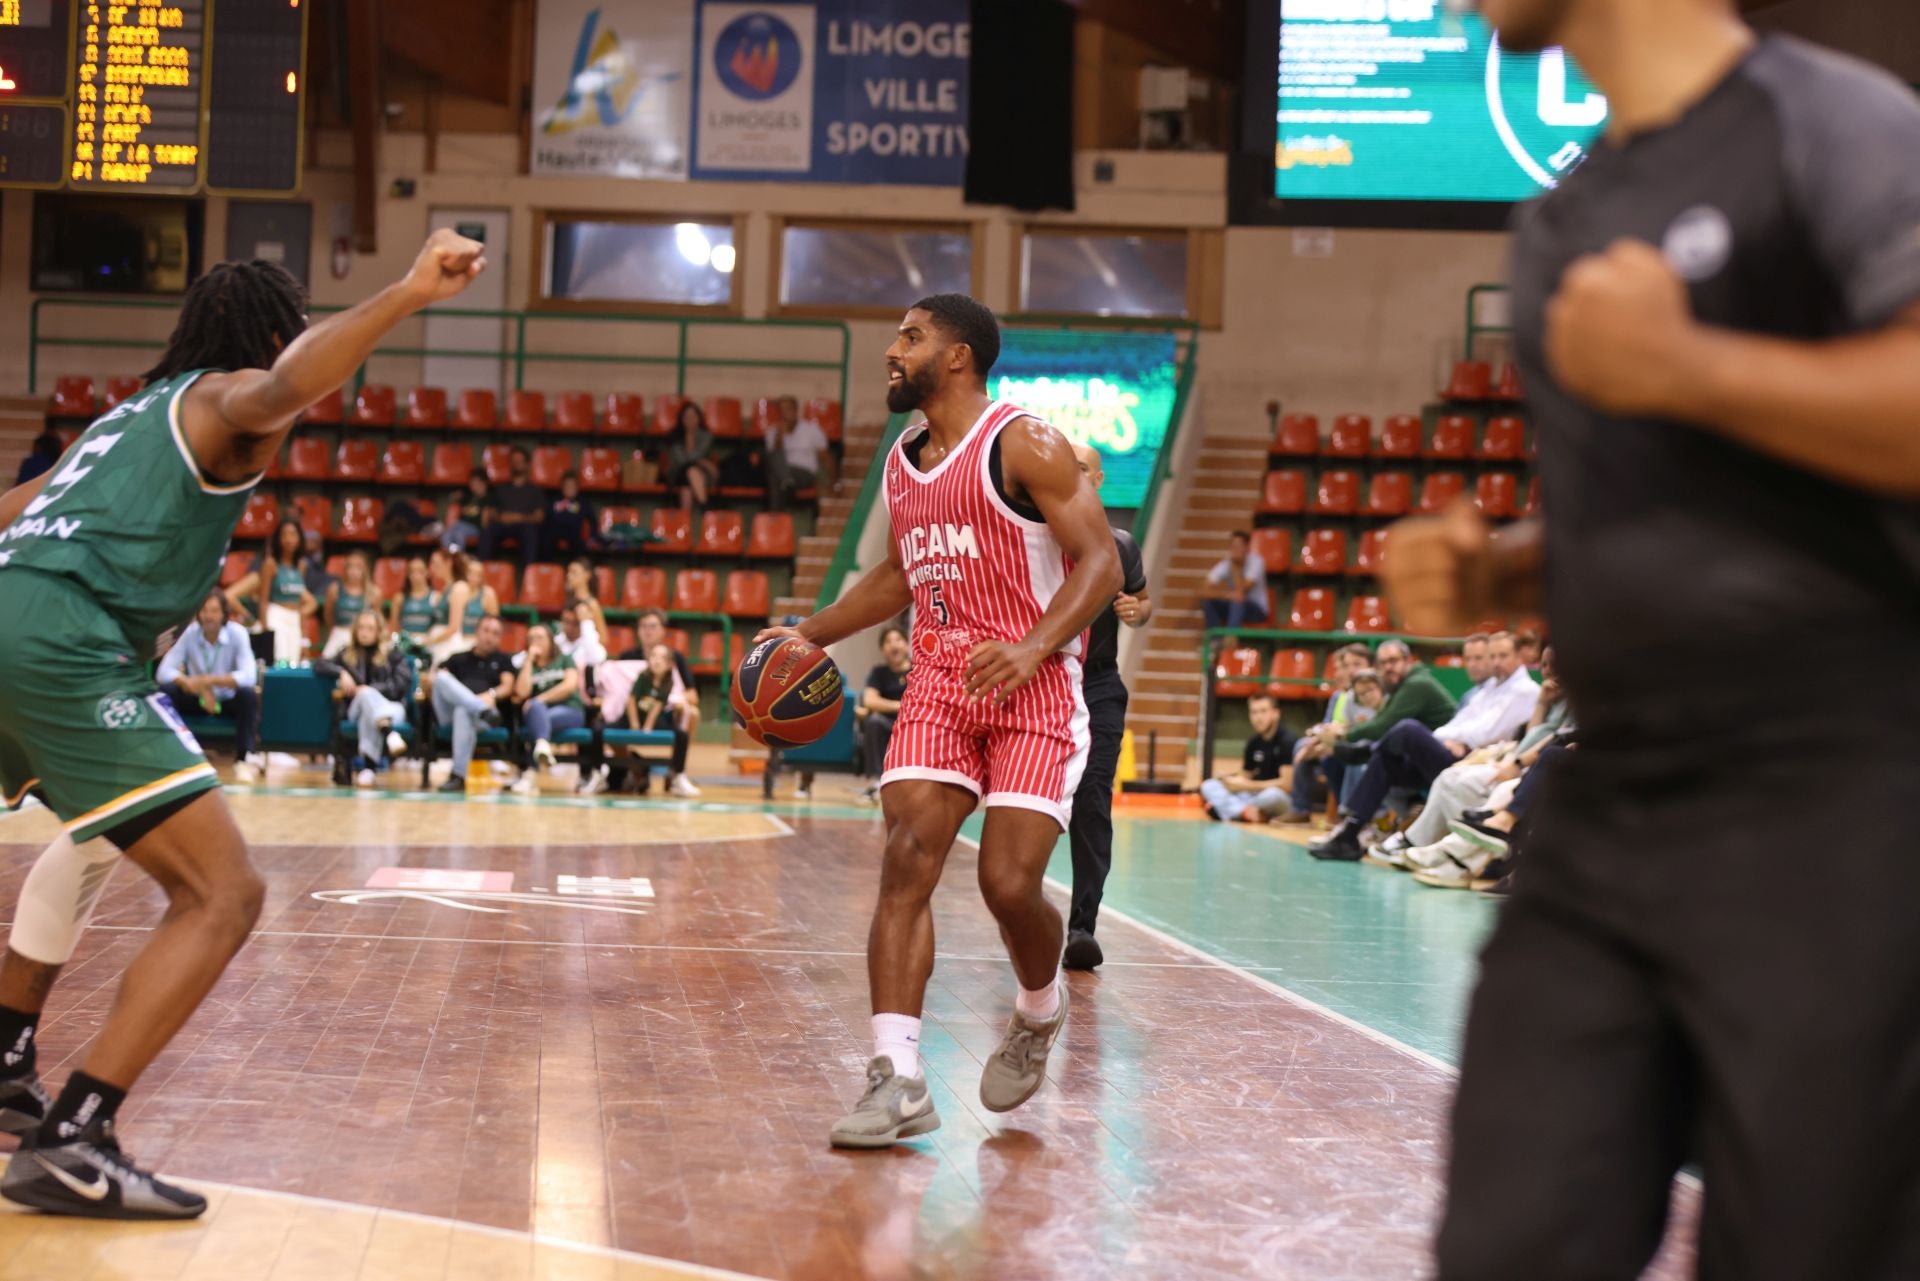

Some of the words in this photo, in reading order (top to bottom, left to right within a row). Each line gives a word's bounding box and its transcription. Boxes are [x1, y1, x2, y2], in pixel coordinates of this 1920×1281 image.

[864, 78, 958, 112] VILLE
[899, 523, 980, 570] UCAM
[908, 563, 964, 591] MURCIA
[931, 585, 949, 626] 5
